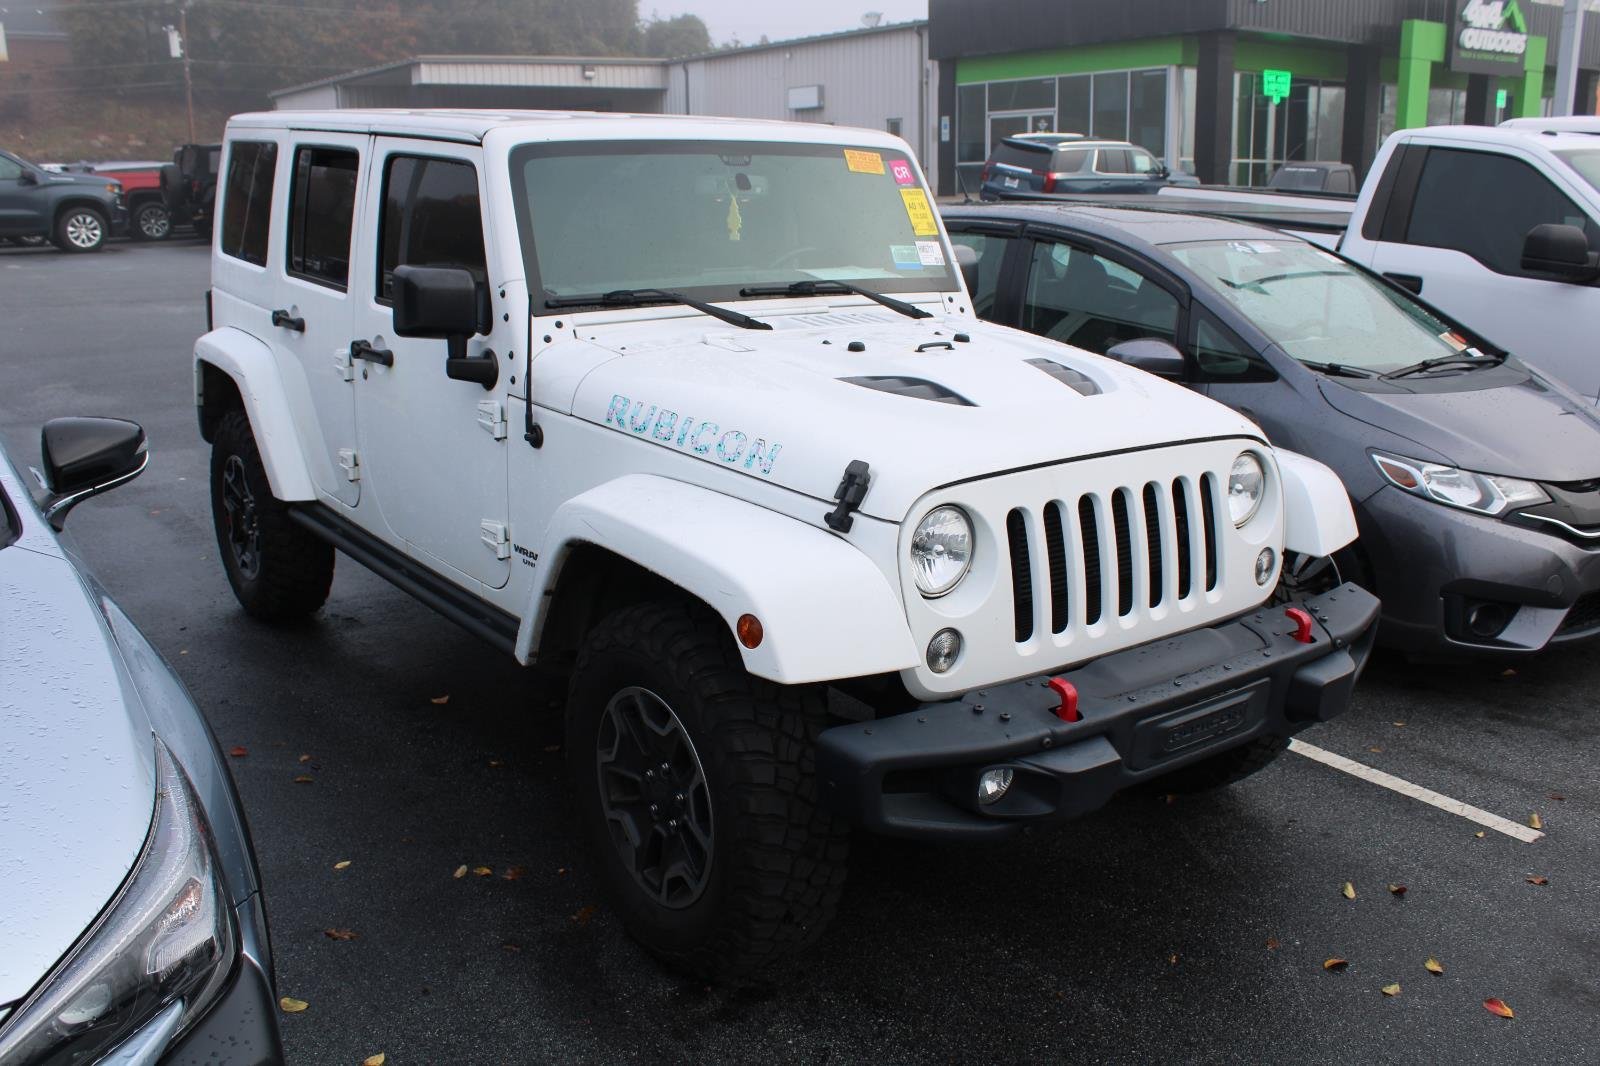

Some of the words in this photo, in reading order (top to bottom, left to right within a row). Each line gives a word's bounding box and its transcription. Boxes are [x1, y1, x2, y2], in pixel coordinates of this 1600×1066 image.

[1459, 27, 1527, 54] OUTDOORS
[893, 166, 911, 180] CR
[605, 394, 783, 475] RUBICON
